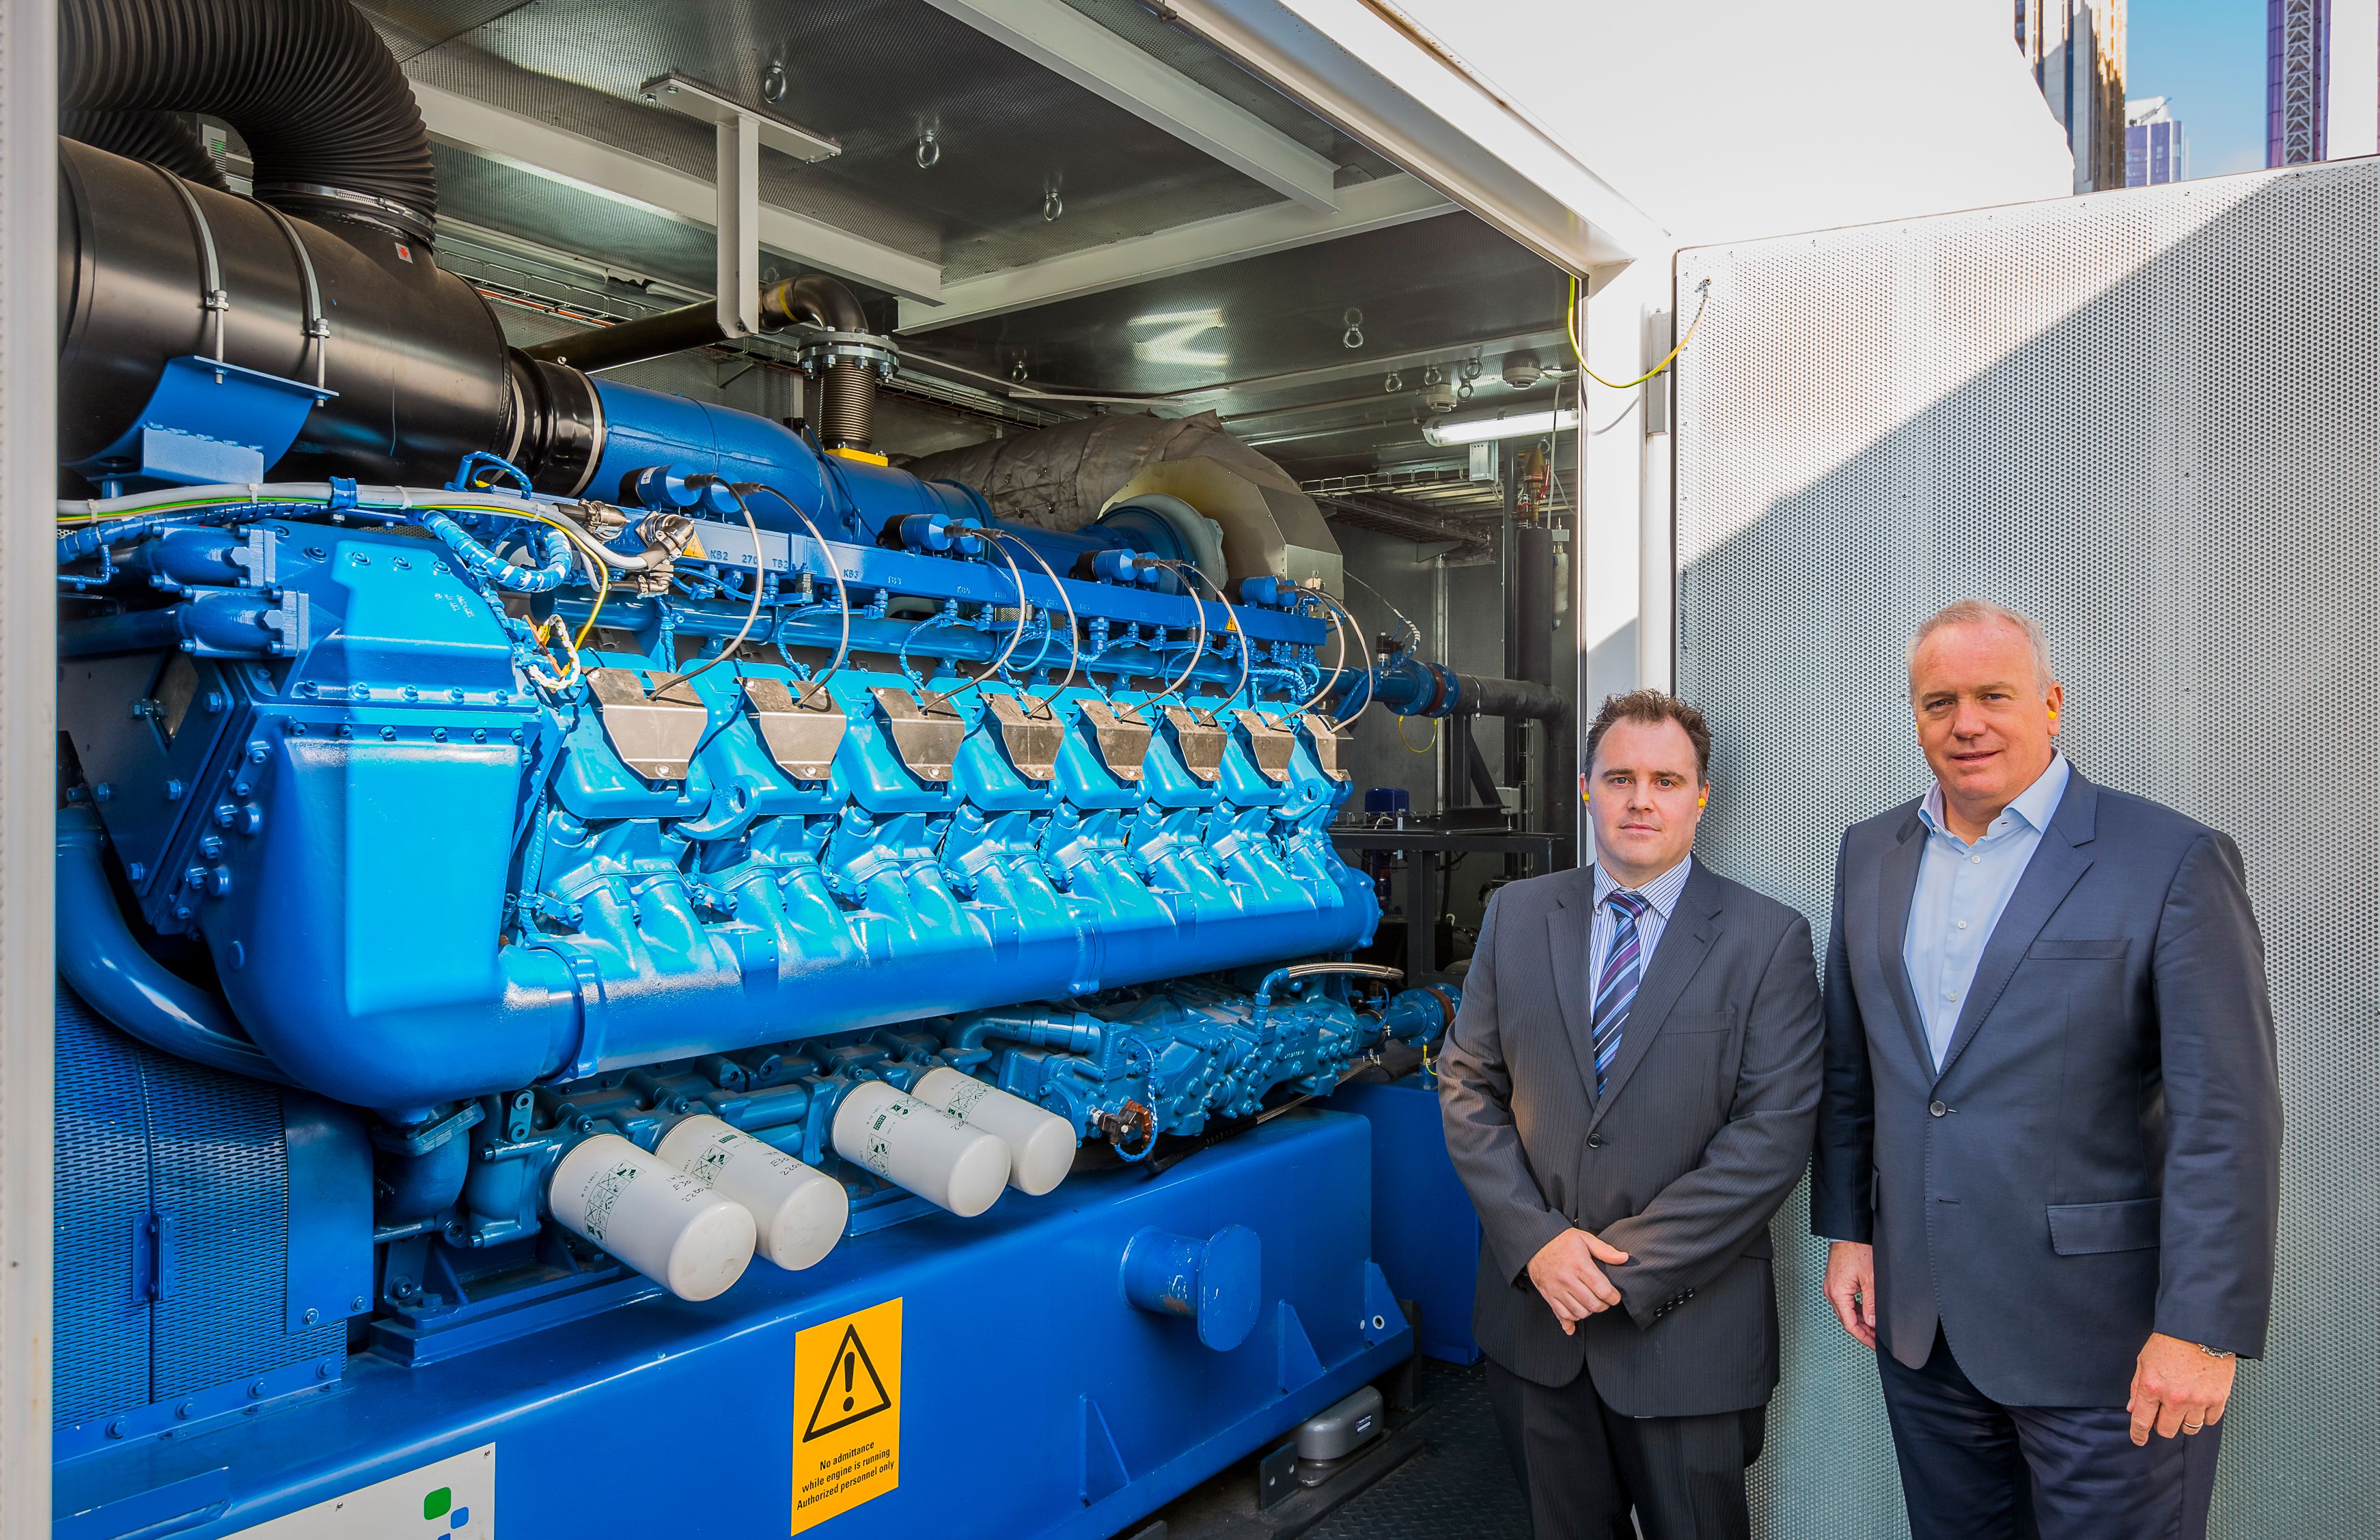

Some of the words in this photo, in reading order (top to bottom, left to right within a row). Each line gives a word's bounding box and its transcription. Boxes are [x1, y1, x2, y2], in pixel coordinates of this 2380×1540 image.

[710, 550, 728, 561] KB2
[772, 558, 788, 569] TB2
[844, 569, 859, 579] KB3
[673, 1180, 691, 1191] E30
[802, 1477, 825, 1493] while
[827, 1466, 852, 1483] engine
[854, 1461, 861, 1470] is
[863, 1448, 890, 1467] running
[820, 1459, 831, 1471] No
[833, 1442, 874, 1466] admittance
[797, 1483, 838, 1511] Authorized
[840, 1466, 877, 1493] personnel
[879, 1460, 894, 1473] only
